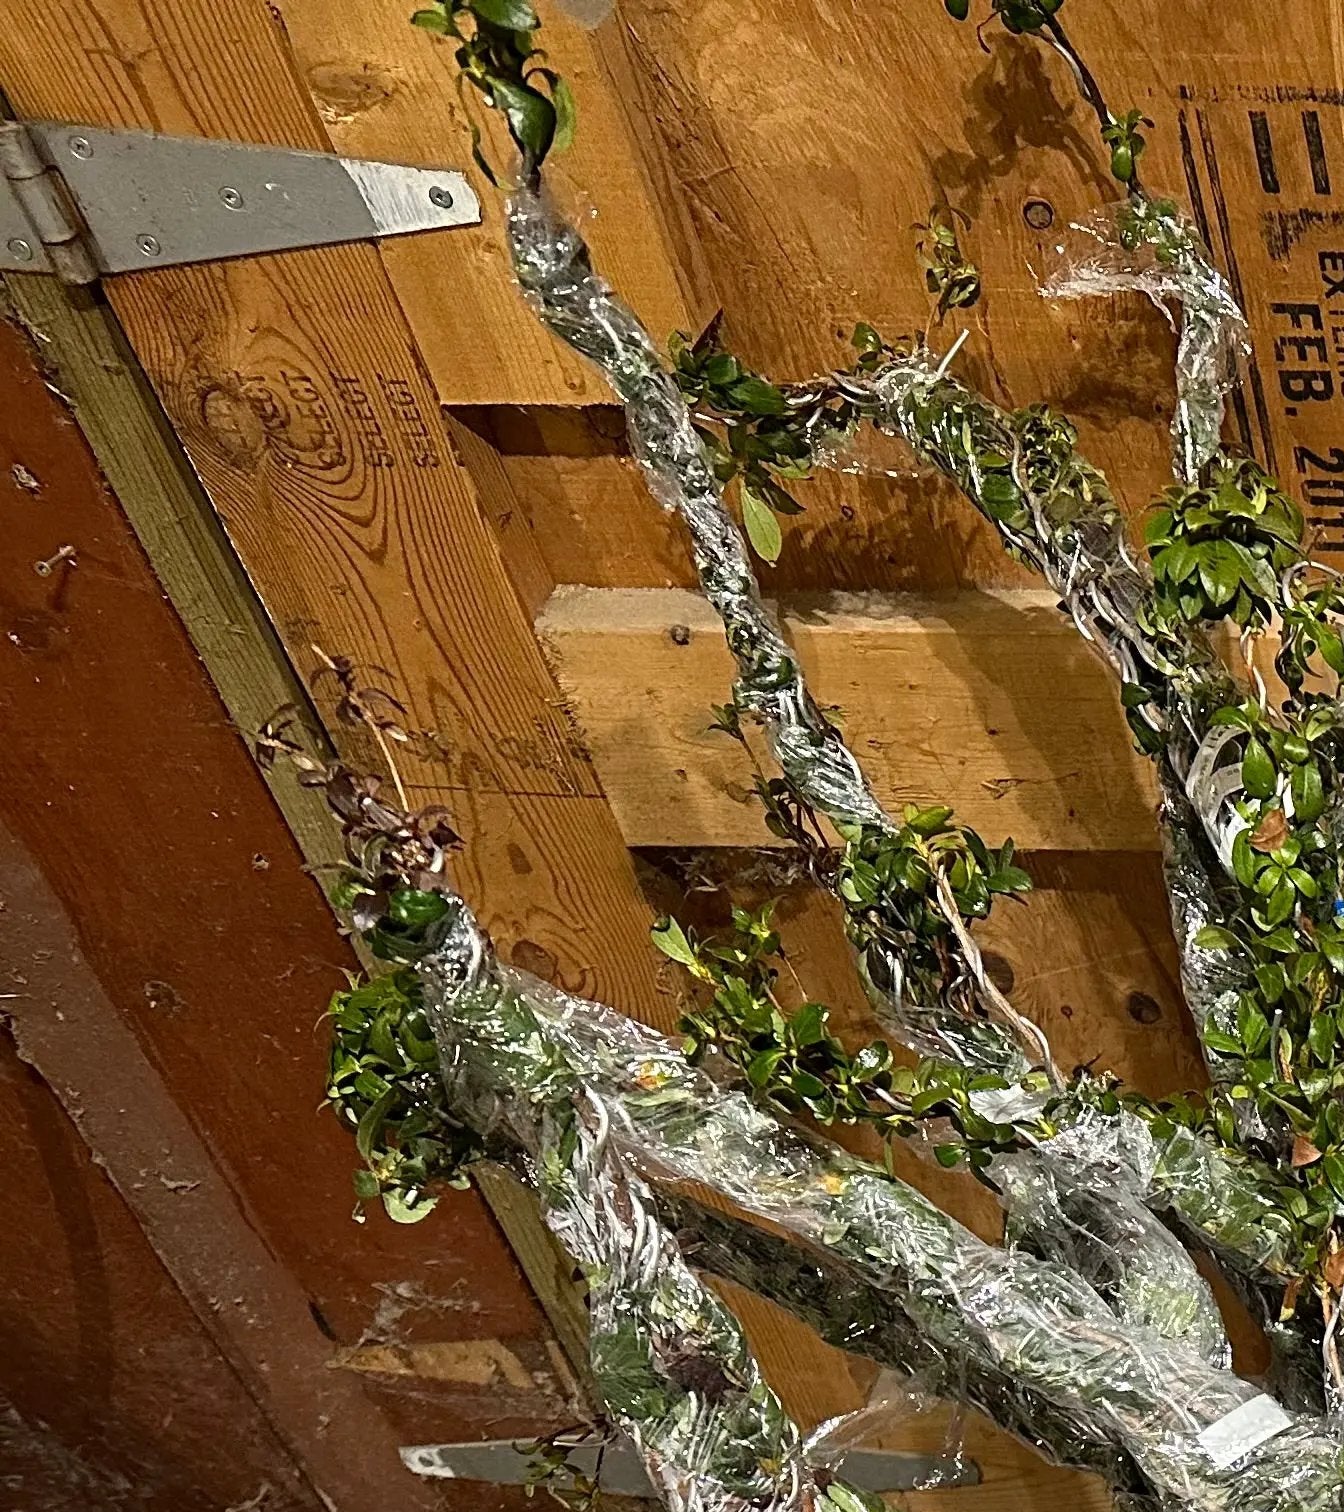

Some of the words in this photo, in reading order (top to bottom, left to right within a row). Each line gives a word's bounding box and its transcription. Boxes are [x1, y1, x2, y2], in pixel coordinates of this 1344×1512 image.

[1269, 302, 1335, 417] FEB.
[329, 370, 395, 469] SELECT
[377, 372, 440, 470] SELECT
